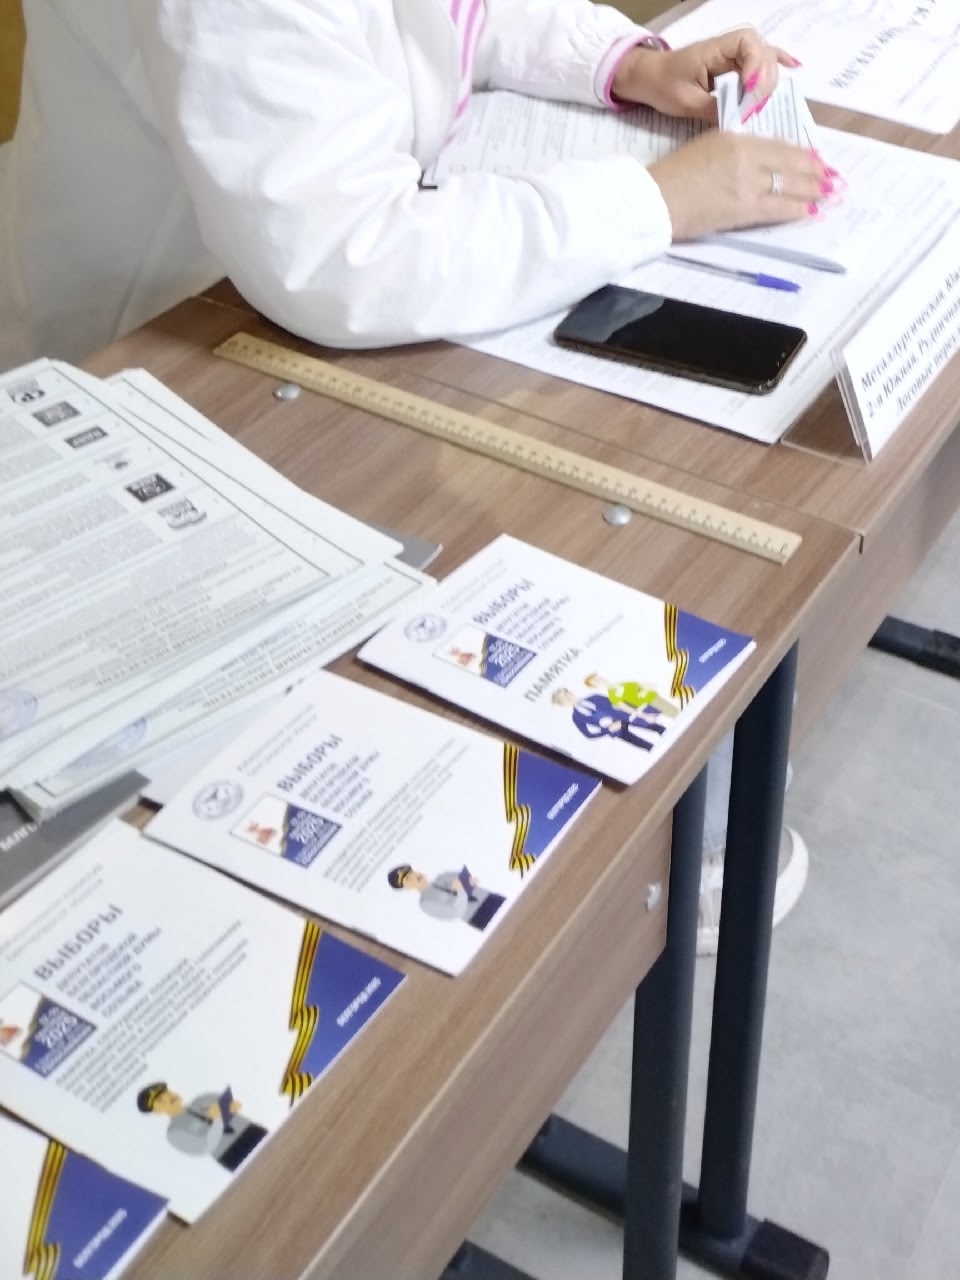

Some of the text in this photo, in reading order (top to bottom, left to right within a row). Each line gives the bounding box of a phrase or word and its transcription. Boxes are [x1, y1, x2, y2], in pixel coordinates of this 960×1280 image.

[472, 577, 535, 625] ВЫБОРЫ
[524, 646, 583, 704] ПАМЯТКА
[276, 733, 343, 793] ВЫБОРЫ
[34, 903, 124, 983] ВЫБОРЫ
